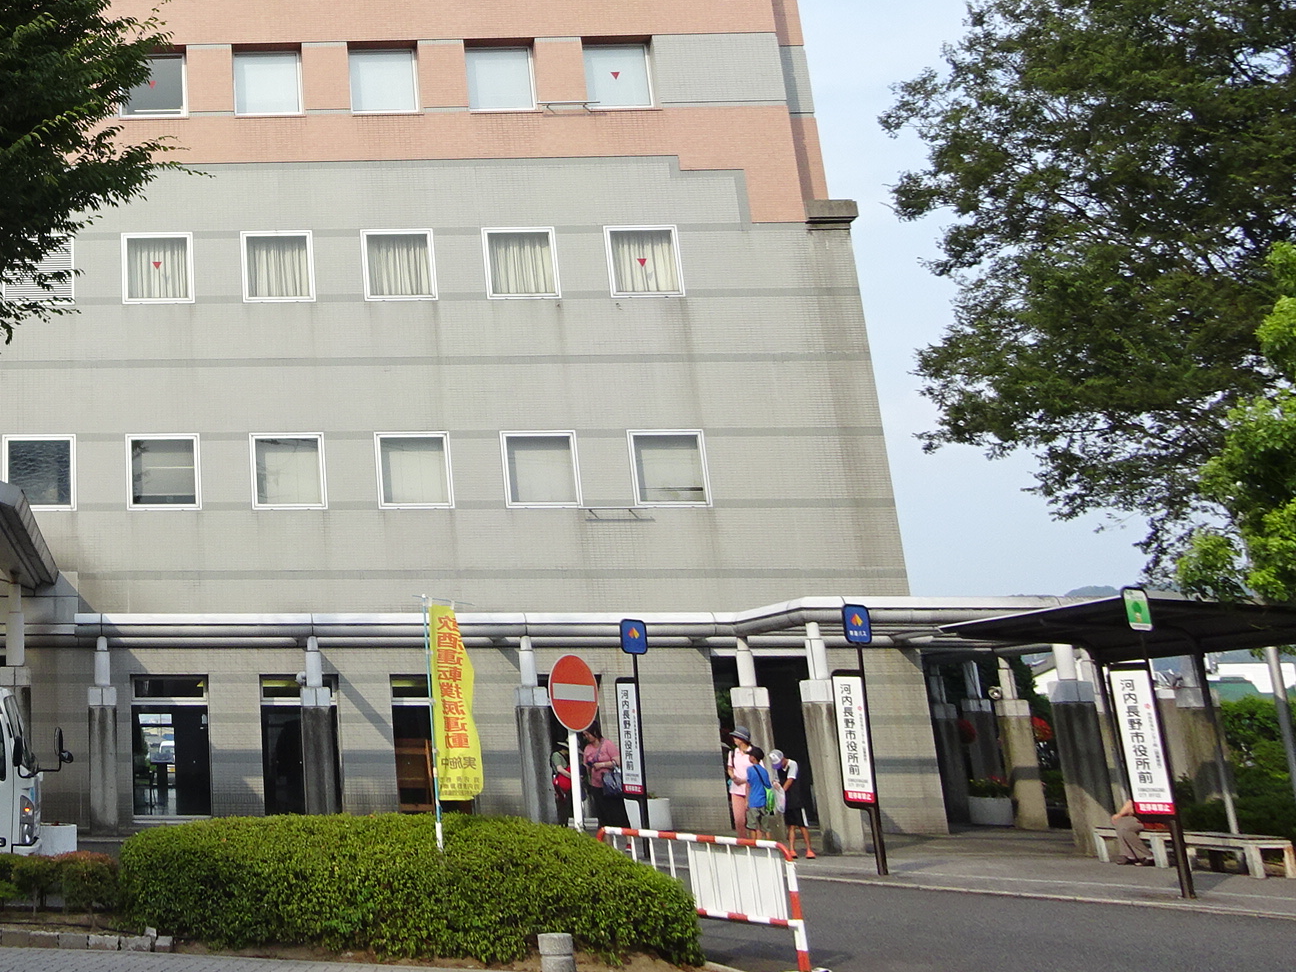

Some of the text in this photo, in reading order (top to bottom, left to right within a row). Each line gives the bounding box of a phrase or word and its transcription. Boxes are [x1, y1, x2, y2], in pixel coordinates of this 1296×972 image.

[621, 689, 634, 771] 河内長野市役所前
[840, 683, 860, 776] 河内長野市役所前
[1120, 678, 1153, 784] 河内長野市役所前
